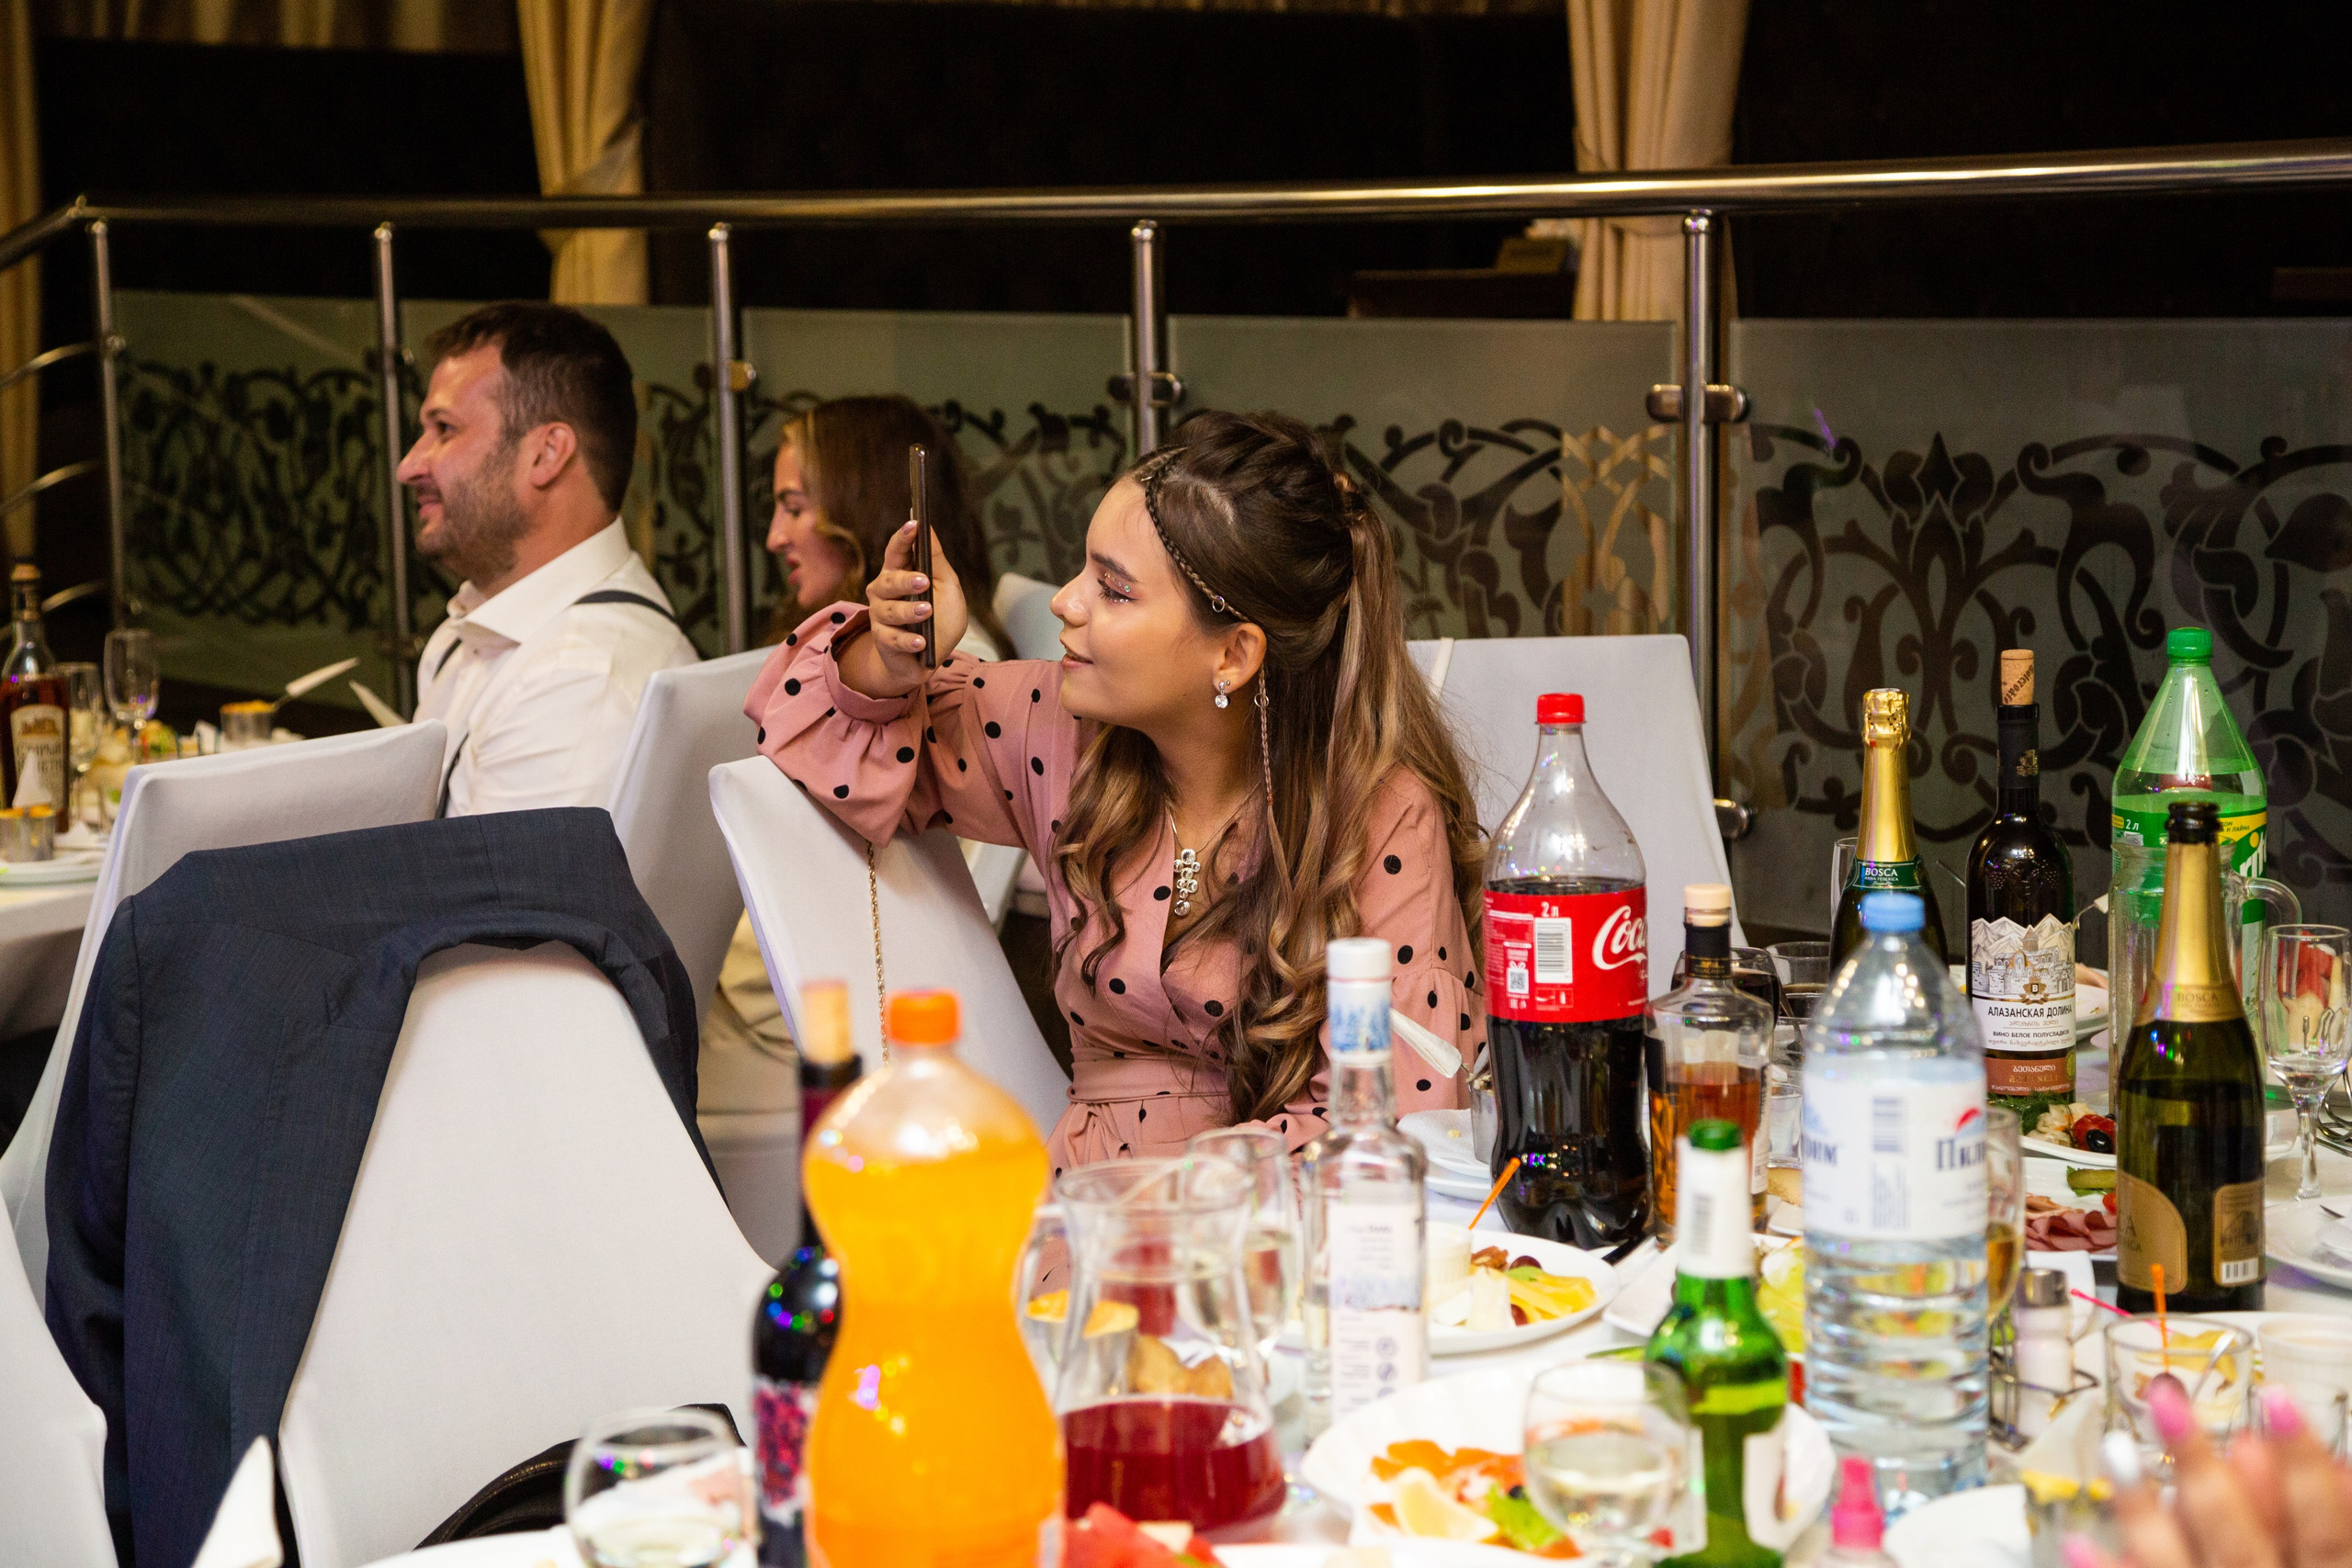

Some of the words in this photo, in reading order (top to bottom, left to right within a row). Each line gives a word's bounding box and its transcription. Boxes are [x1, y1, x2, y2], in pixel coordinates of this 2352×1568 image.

[2125, 818, 2132, 829] 2
[1865, 867, 1898, 877] BOSCA
[1541, 901, 1550, 917] 2
[1988, 1007, 2044, 1018] АЛАЗАНСКАЯ
[2047, 1005, 2072, 1018] ДОЛИНА
